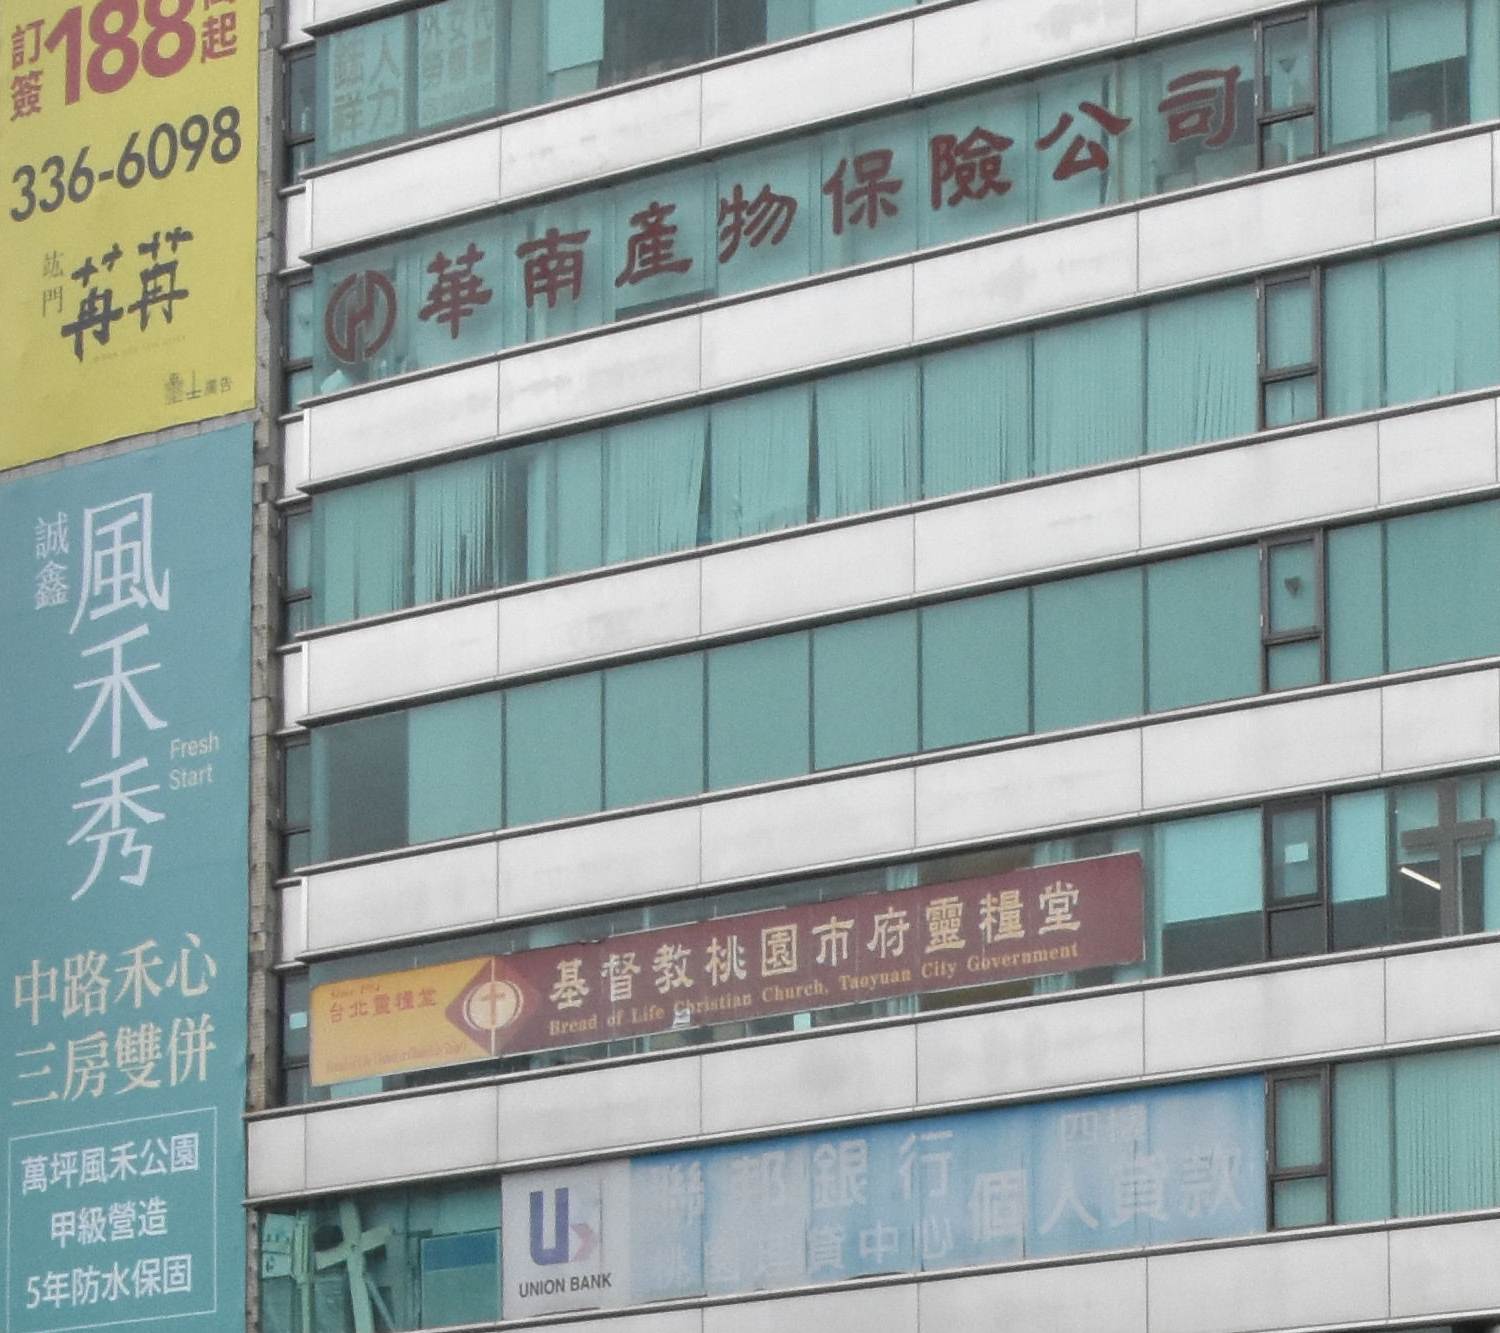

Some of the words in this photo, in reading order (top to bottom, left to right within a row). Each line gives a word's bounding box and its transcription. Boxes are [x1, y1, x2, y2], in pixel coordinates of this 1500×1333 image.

[10, 19, 44, 122] 訂簽
[44, 0, 197, 106] 188
[10, 106, 242, 222] 336-6098
[418, 65, 1242, 338] 華南產物保險公司
[33, 516, 69, 611] 誠鑫
[66, 490, 170, 902] 風禾秀
[169, 763, 213, 791] Start
[170, 731, 219, 759] Fresh
[14, 932, 218, 1027] 中路禾心
[548, 880, 1082, 1011] 基督教桃園市府靈糧堂
[548, 1013, 598, 1038] Bread
[606, 1008, 624, 1027] of
[631, 1003, 665, 1024] Life
[673, 991, 754, 1016] Christian
[838, 967, 913, 995] Taoyuan
[921, 957, 958, 981] City
[966, 940, 1081, 975] Government
[11, 1014, 217, 1108] 三房雙併
[19, 1132, 200, 1196] 萬坪風禾公園
[643, 1129, 955, 1223] 聯邦銀行
[967, 1144, 1248, 1246] 個人貸款
[50, 1198, 169, 1250] 甲級營造
[25, 1254, 193, 1311] 5年防水保固
[518, 1277, 566, 1298] UNION
[569, 1271, 612, 1294] BANK
